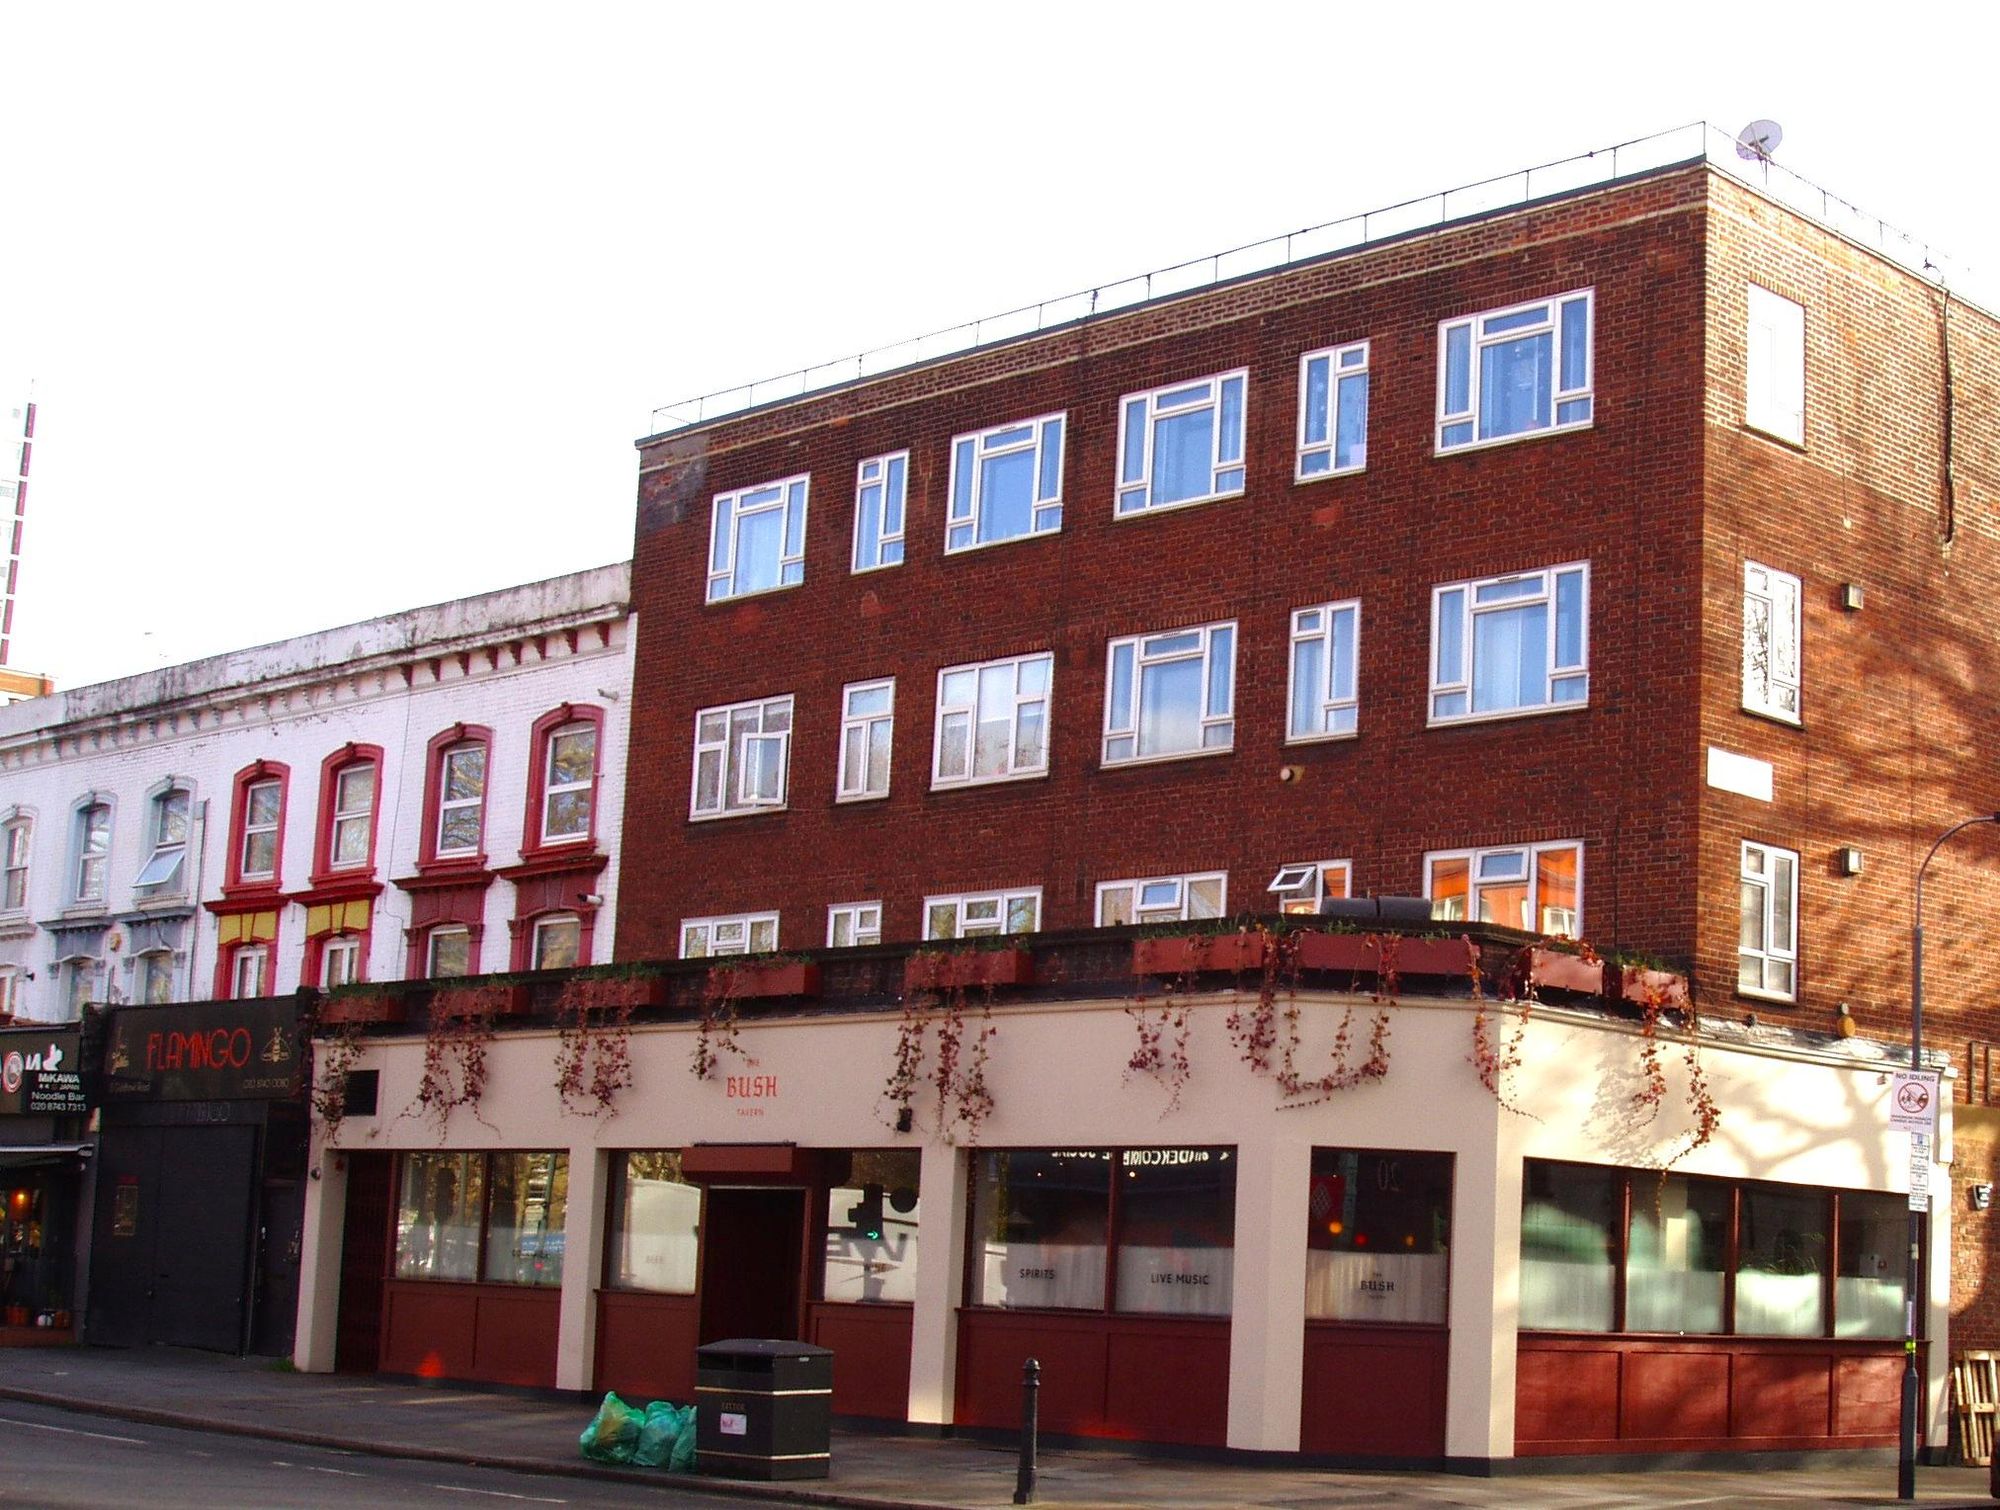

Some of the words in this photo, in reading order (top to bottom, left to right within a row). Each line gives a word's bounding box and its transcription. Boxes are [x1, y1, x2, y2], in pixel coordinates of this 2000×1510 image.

[147, 1027, 252, 1072] FLAMINGO
[1909, 1074, 1935, 1082] IDLING
[727, 1075, 777, 1098] BUSH
[32, 1092, 66, 1101] Noodle
[68, 1093, 86, 1101] Bar
[31, 1102, 46, 1111] 020
[1020, 1269, 1056, 1280] SPIRITS
[1151, 1273, 1173, 1284] LIVE
[1176, 1274, 1209, 1286] MUSIC
[1361, 1280, 1394, 1291] BUSH
